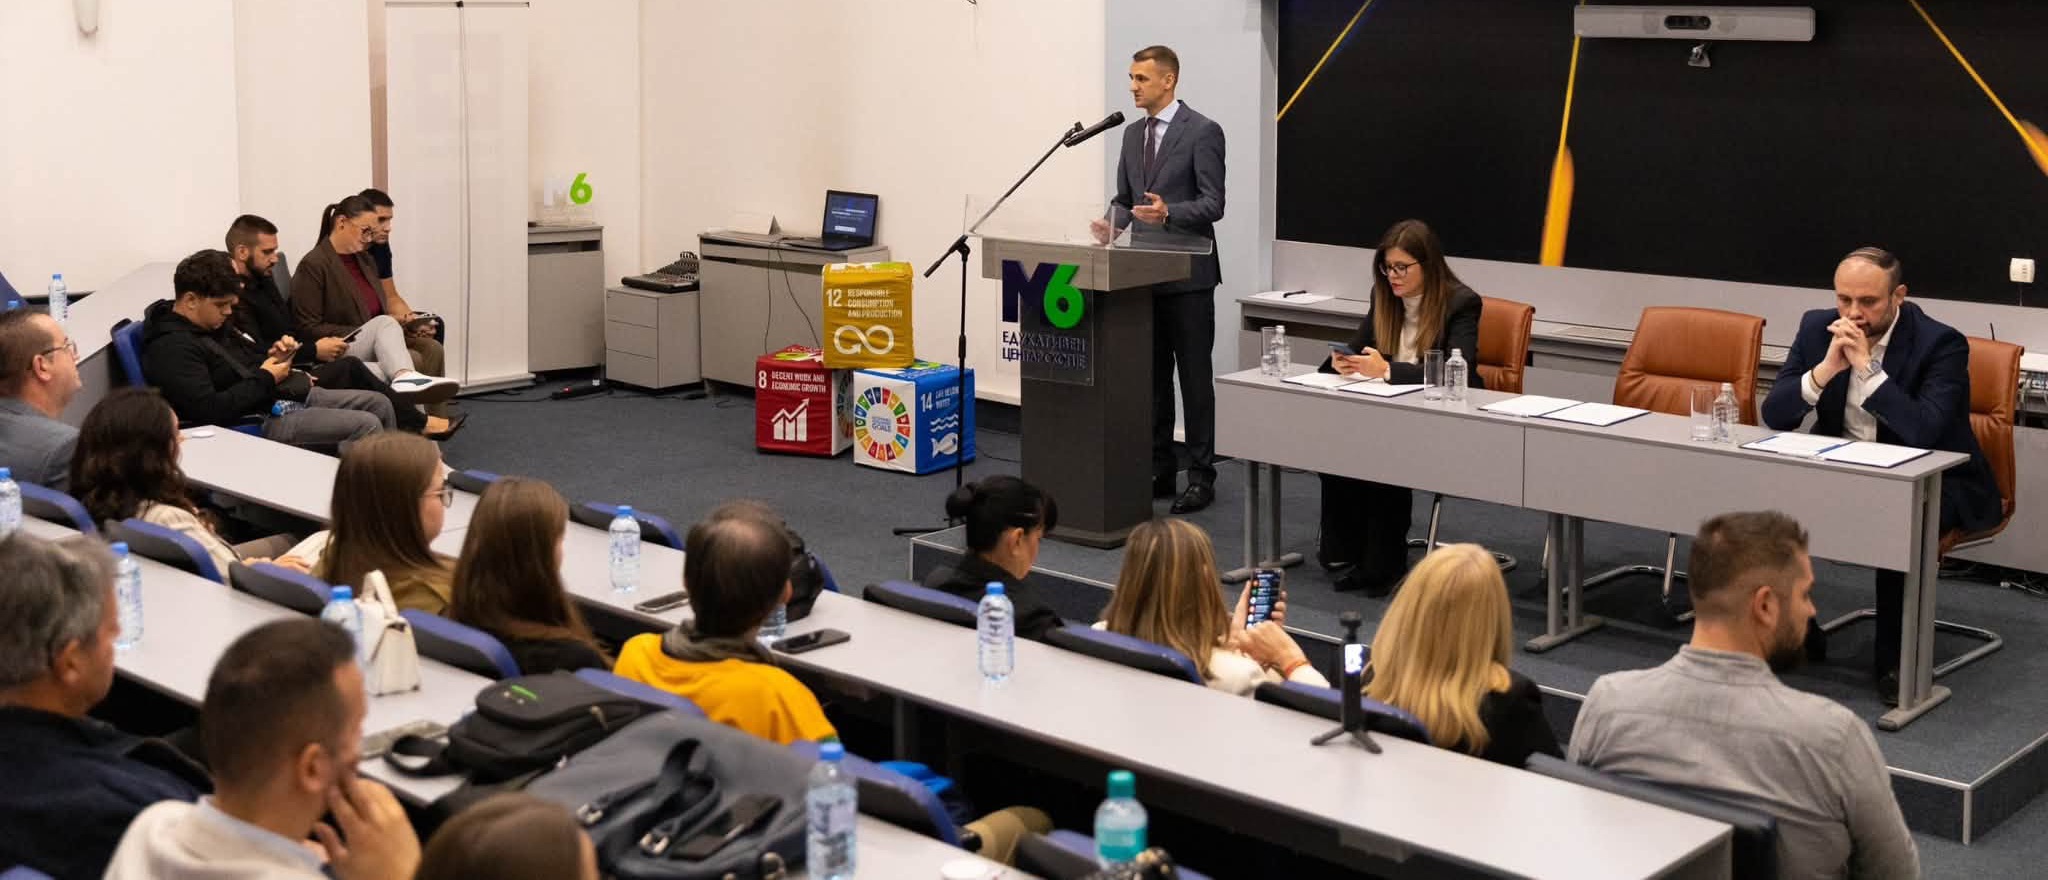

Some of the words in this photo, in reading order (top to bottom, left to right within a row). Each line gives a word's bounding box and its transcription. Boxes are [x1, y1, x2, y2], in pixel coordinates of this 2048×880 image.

[826, 288, 842, 307] 12
[847, 299, 895, 308] CONSUMPTION
[1002, 259, 1085, 329] M6
[847, 309, 862, 319] AND
[863, 309, 903, 319] PRODUCTION
[1002, 330, 1086, 353] ЕДУКАТИВЕН
[758, 370, 767, 389] 8
[771, 371, 793, 380] DECENT
[794, 372, 812, 382] WORK
[812, 373, 825, 382] AND
[771, 381, 801, 391] ECONOMIC
[801, 384, 826, 393] GROWTH
[920, 392, 932, 412] 14
